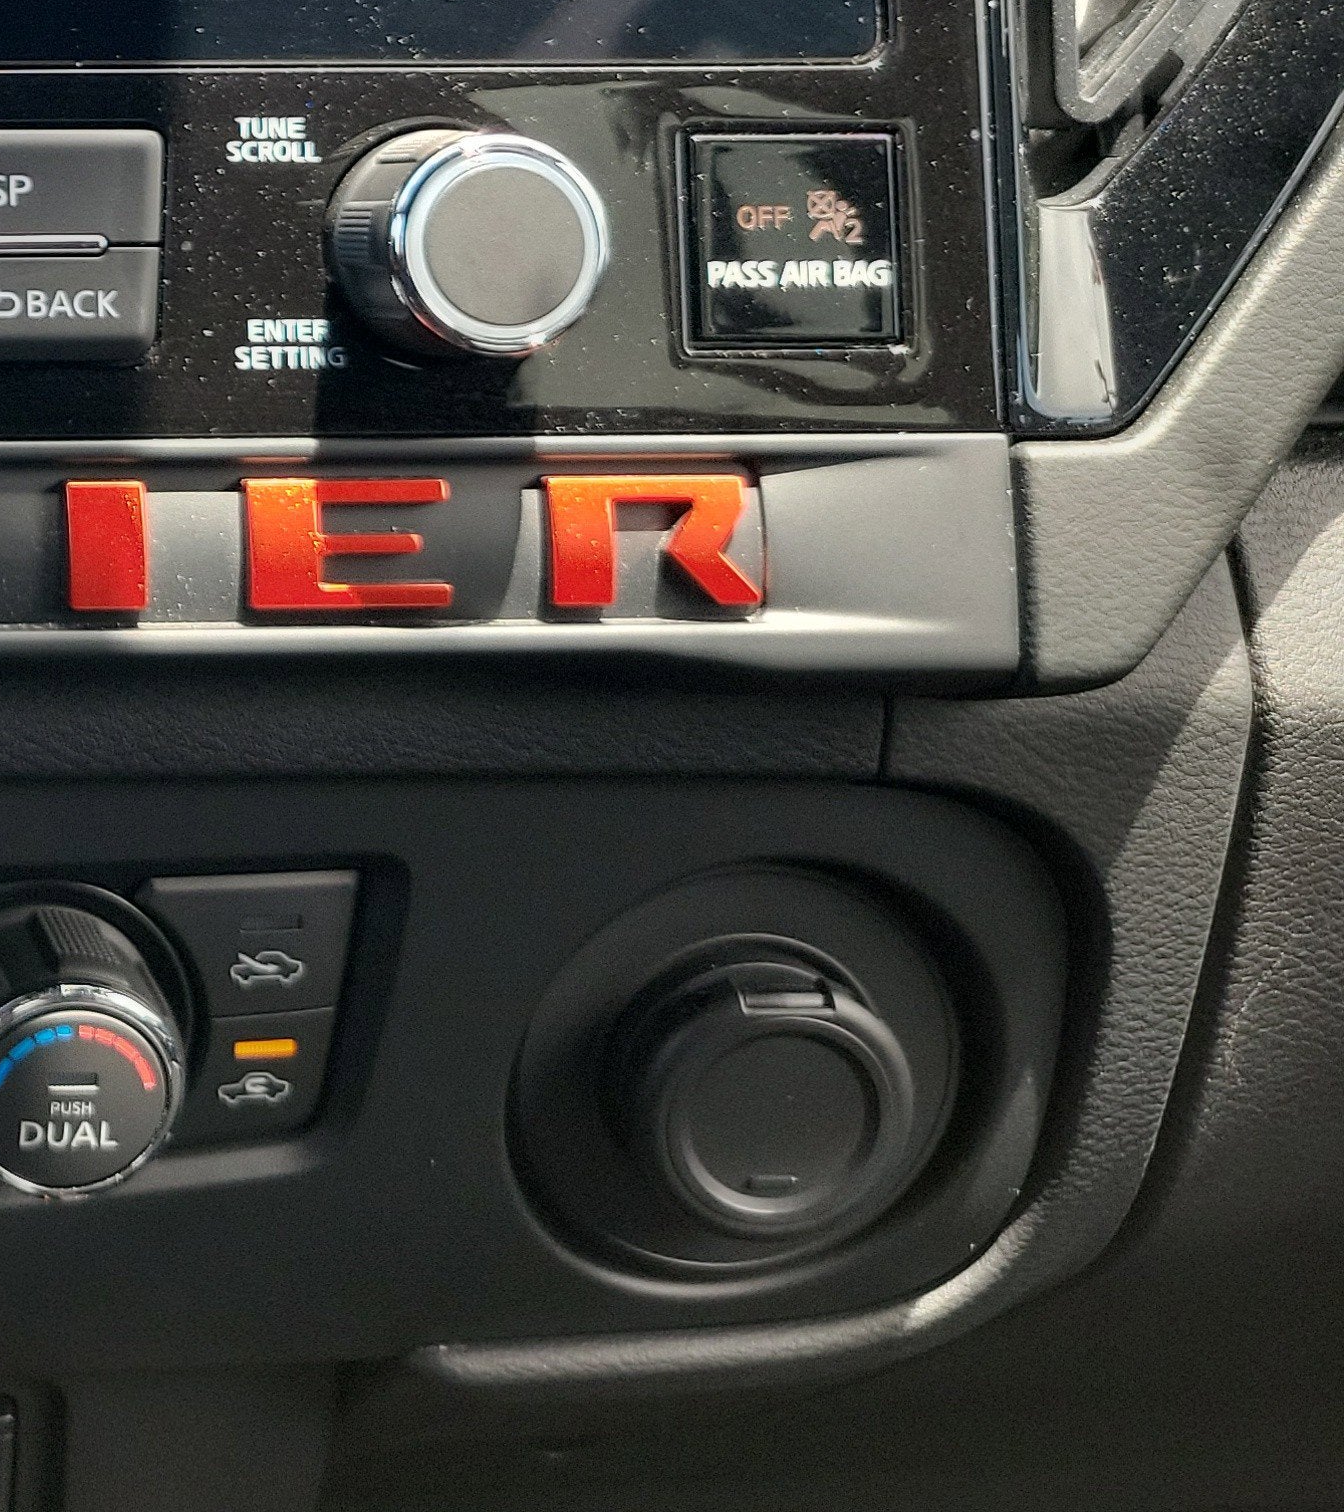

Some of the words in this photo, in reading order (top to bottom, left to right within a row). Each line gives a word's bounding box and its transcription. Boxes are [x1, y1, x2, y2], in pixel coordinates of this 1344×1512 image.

[234, 116, 307, 140] TUNE
[225, 140, 322, 163] SCROLL
[736, 205, 792, 231] OFF
[706, 260, 778, 288] PASS
[780, 260, 833, 288] AIR
[833, 259, 893, 287] BAG
[26, 290, 119, 320] BACK
[247, 319, 331, 343] ENTER
[234, 346, 348, 370] SETTING
[50, 1101, 92, 1116] PUSH
[19, 1120, 119, 1150] DUAL
